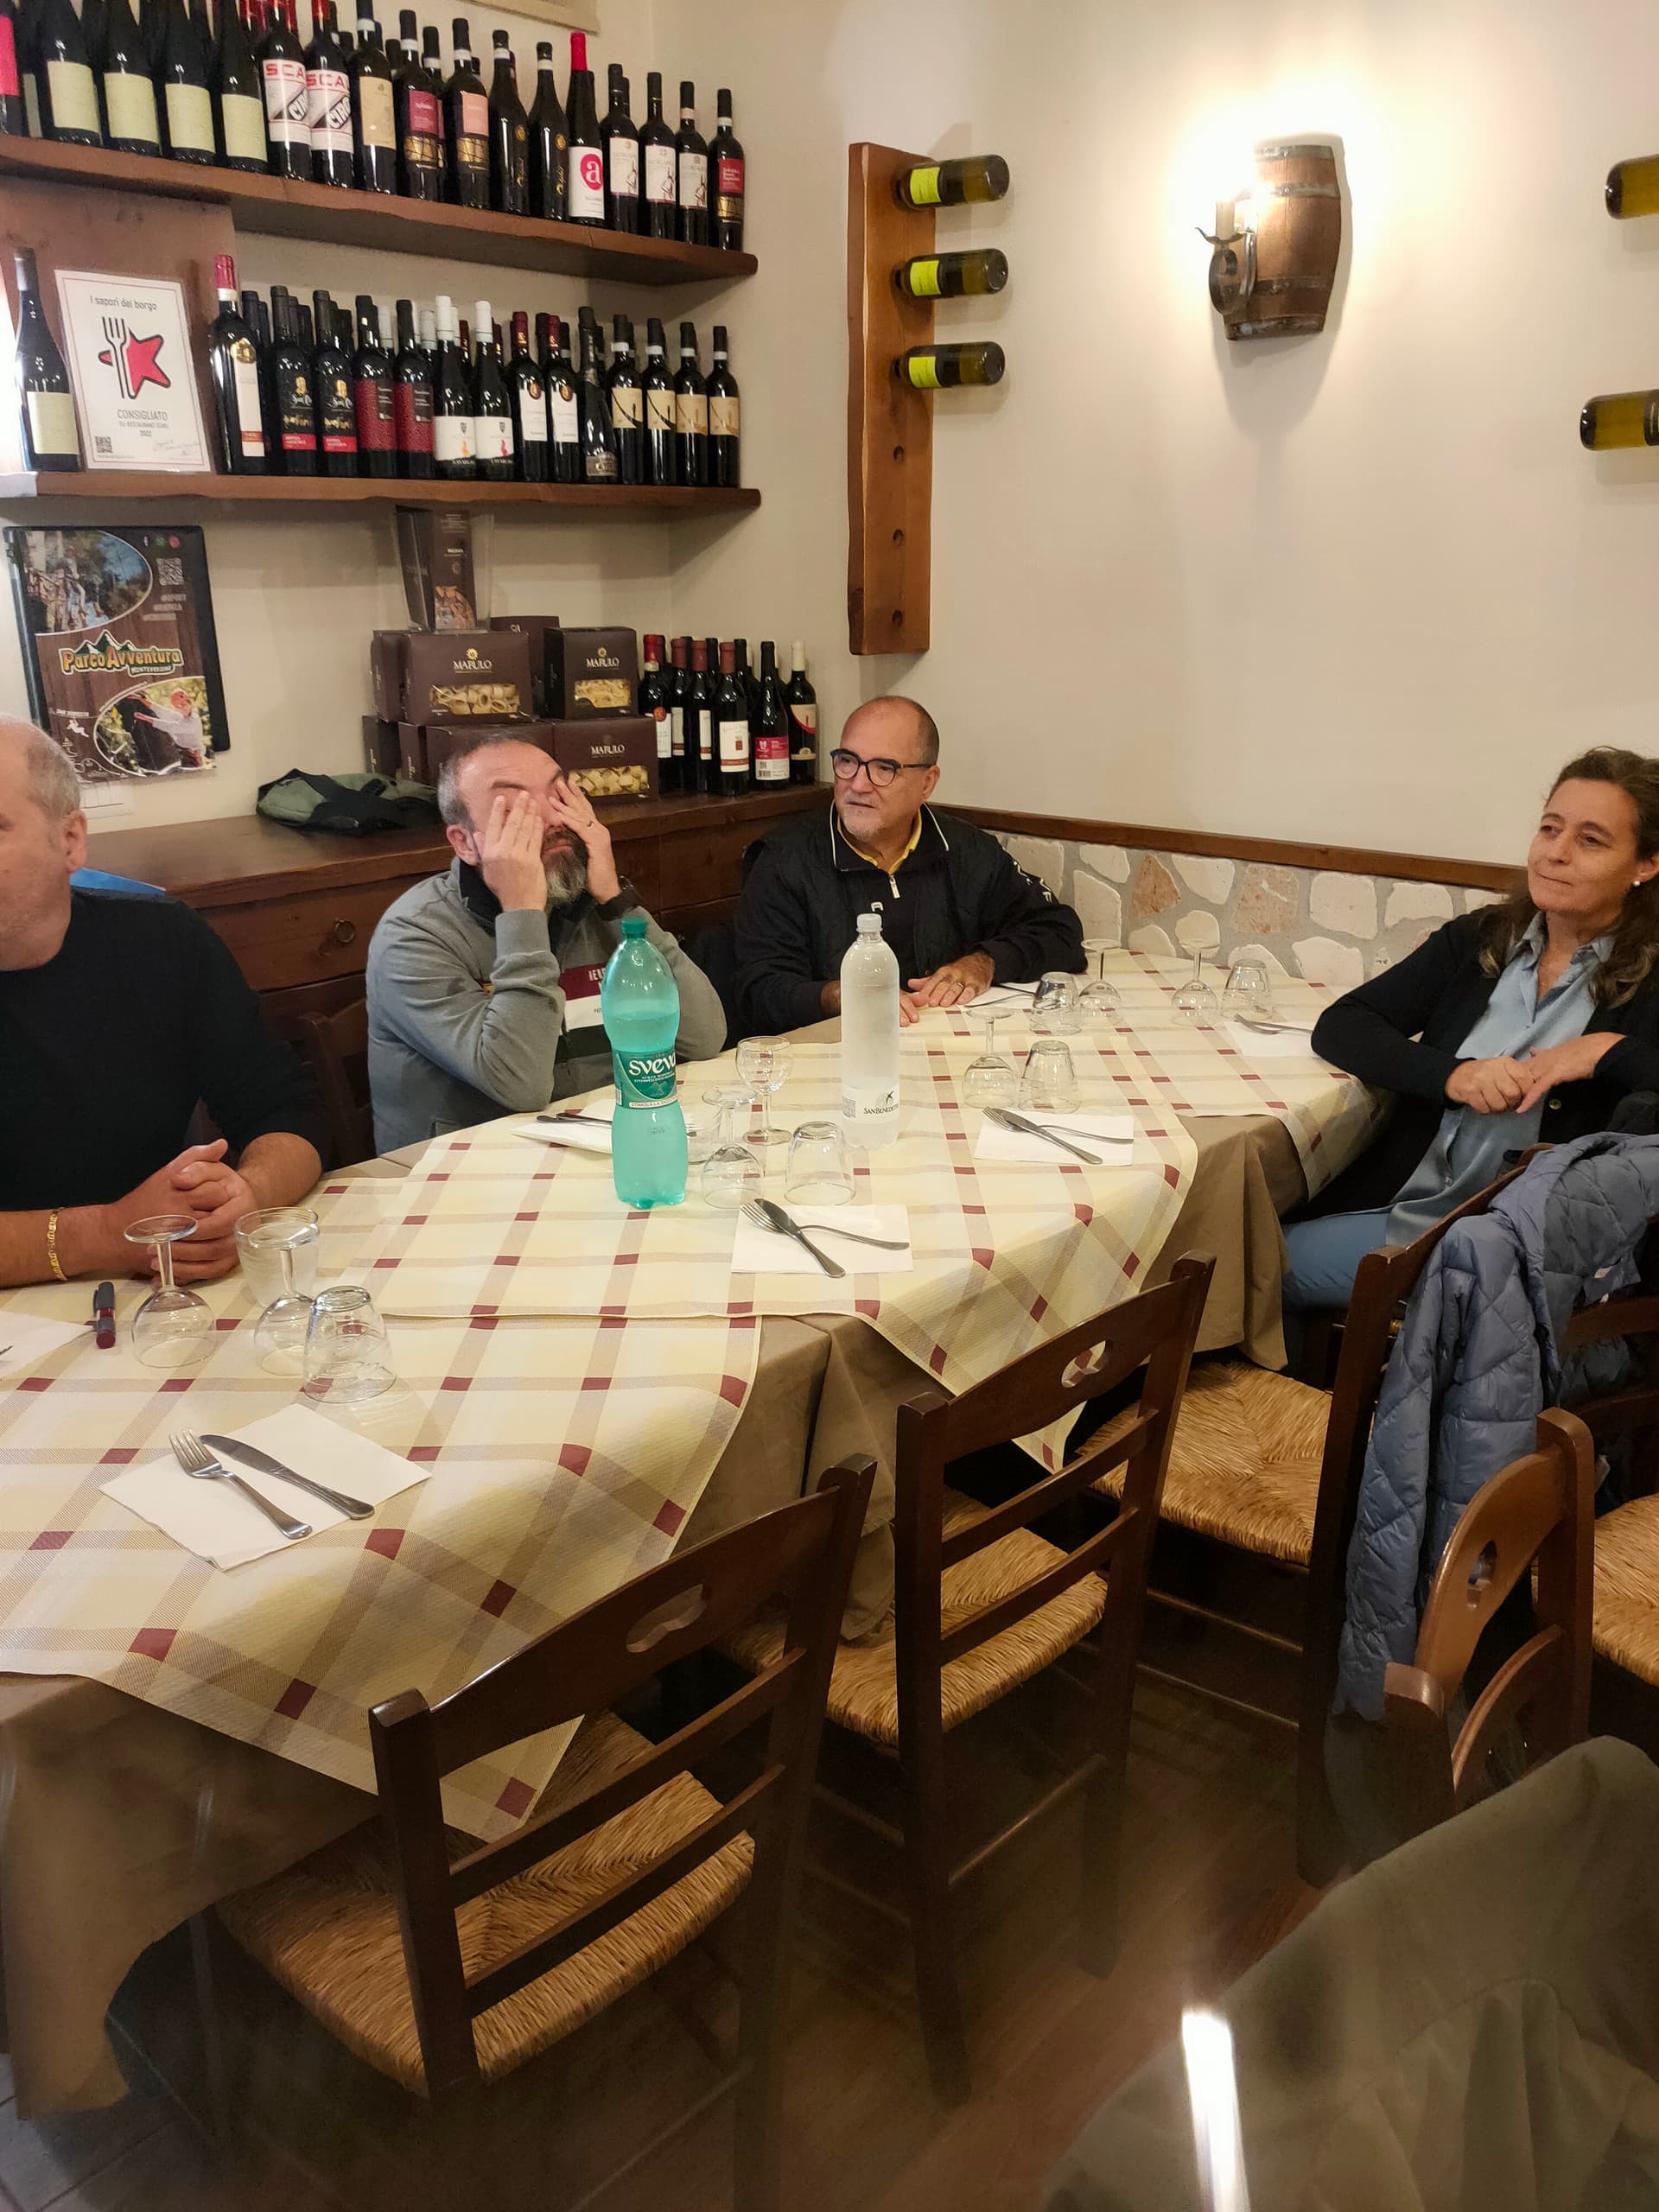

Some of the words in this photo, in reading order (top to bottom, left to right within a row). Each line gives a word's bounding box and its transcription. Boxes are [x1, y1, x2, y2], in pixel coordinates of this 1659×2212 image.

[306, 73, 350, 89] SCA
[94, 296, 120, 308] sapori
[134, 299, 158, 312] borgo
[118, 409, 168, 421] CONSIGLIATO
[62, 650, 105, 671] Parco
[453, 659, 492, 671] MARULO
[587, 657, 620, 668] MARULO
[590, 744, 626, 754] MARULO
